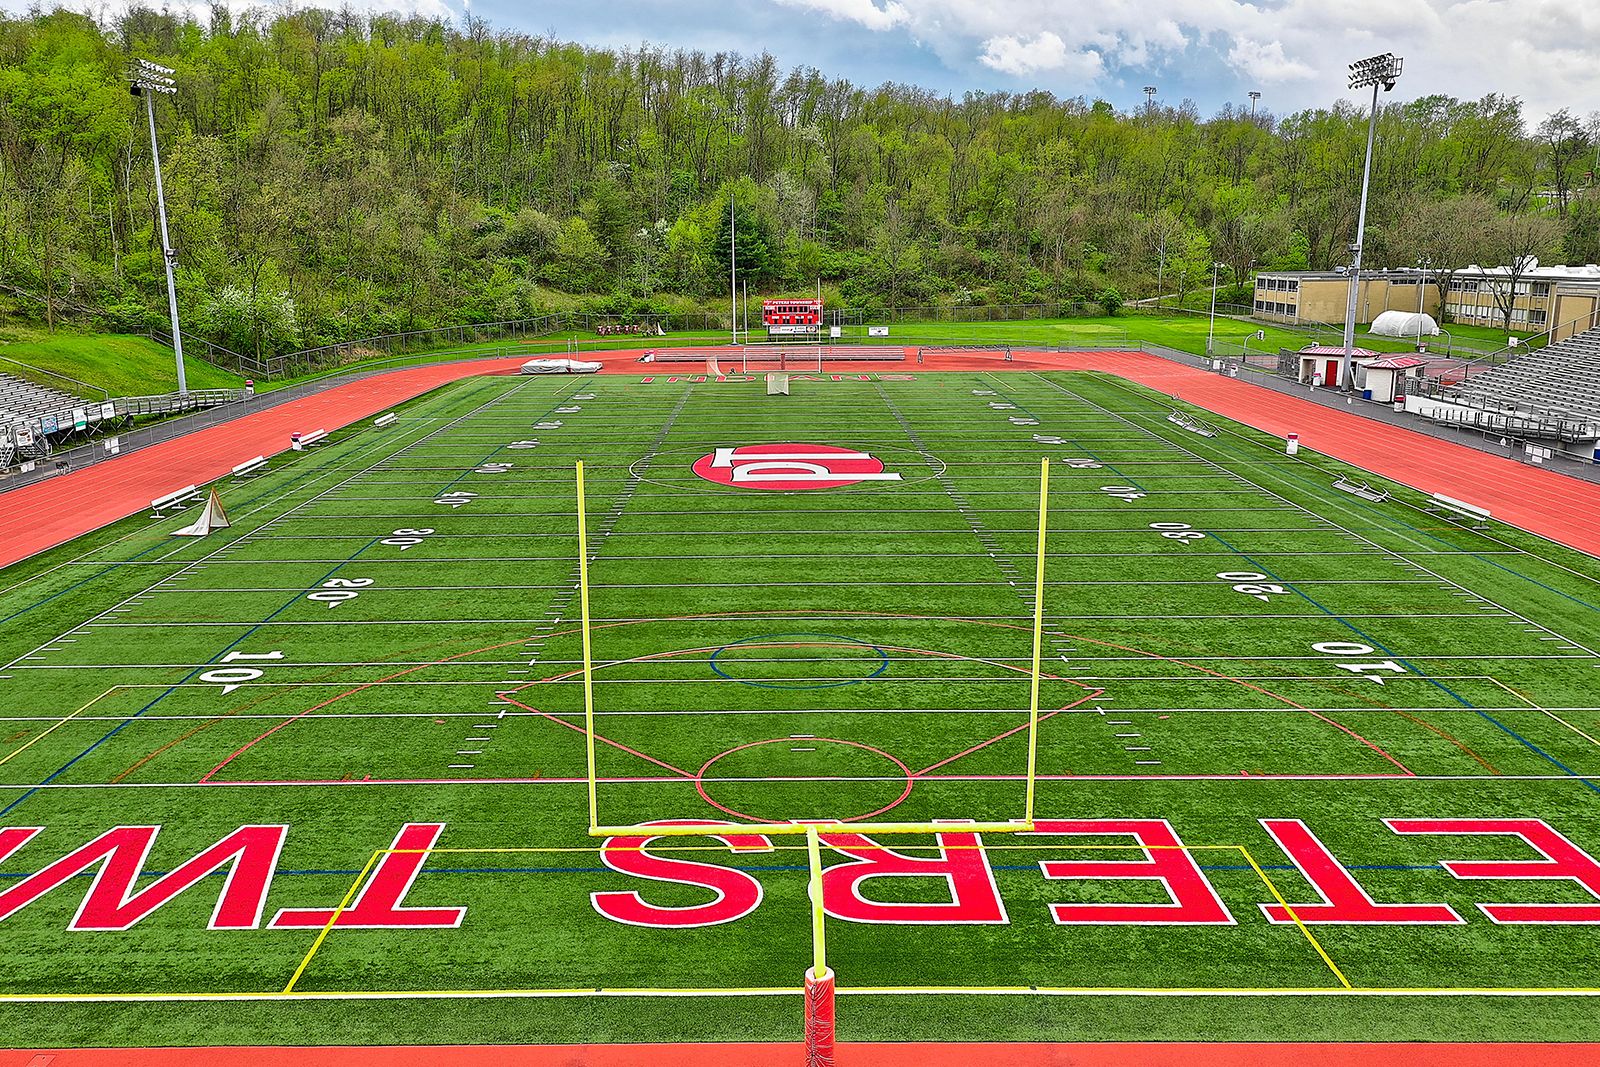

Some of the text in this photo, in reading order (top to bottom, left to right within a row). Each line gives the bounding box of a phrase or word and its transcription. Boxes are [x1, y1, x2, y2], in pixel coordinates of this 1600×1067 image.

[380, 528, 435, 546] 30
[1149, 522, 1206, 540] 30
[306, 577, 375, 602] 20
[1216, 571, 1291, 595] 20
[198, 650, 285, 683] 10
[1311, 641, 1408, 674] 10
